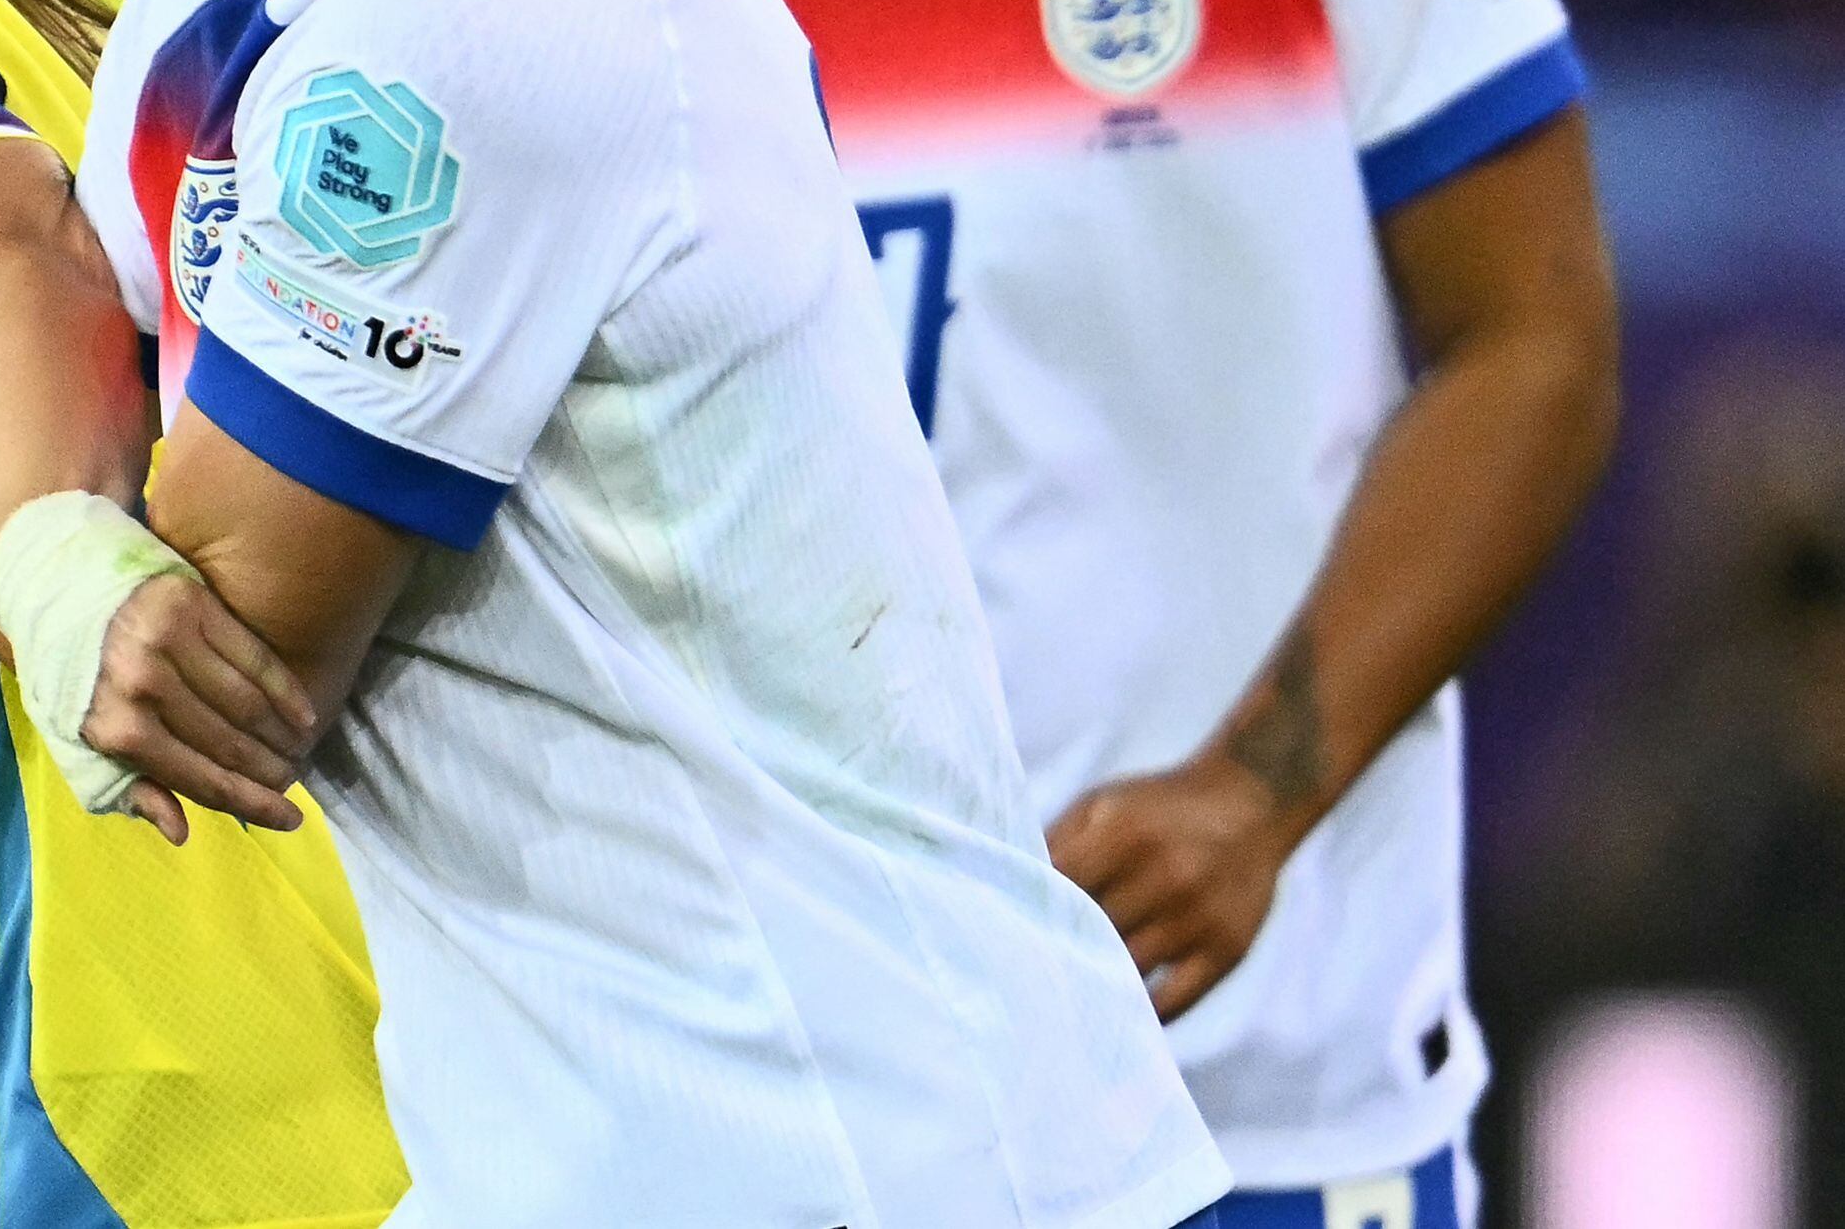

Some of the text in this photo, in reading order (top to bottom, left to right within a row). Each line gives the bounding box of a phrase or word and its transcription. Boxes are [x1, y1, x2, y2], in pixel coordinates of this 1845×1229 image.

[328, 125, 359, 154] We
[321, 149, 370, 185] Play
[318, 170, 392, 214] Strong
[854, 192, 960, 442] 7
[363, 316, 425, 370] 10
